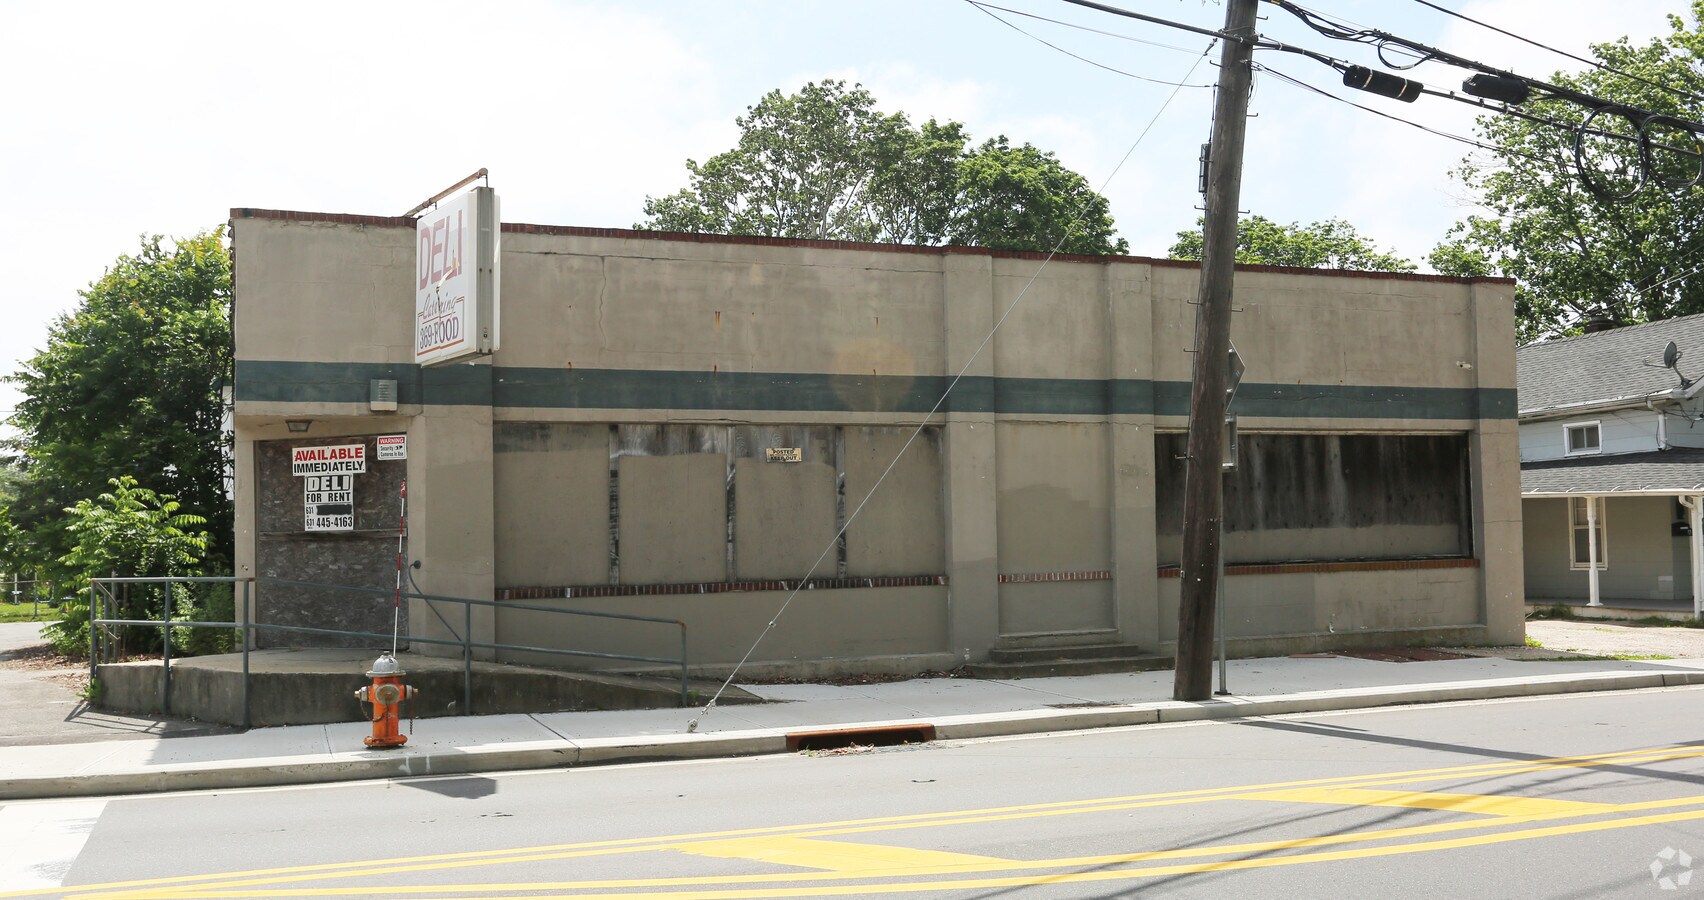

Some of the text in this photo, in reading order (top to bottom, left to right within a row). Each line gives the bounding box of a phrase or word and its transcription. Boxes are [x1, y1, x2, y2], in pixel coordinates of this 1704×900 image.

[420, 210, 462, 290] DELI
[420, 316, 460, 350] 369-FOOD
[295, 448, 363, 461] AVAILABLE
[307, 476, 350, 491] DELI
[306, 492, 350, 502] FOR RENT
[316, 516, 352, 528] 445-4163
